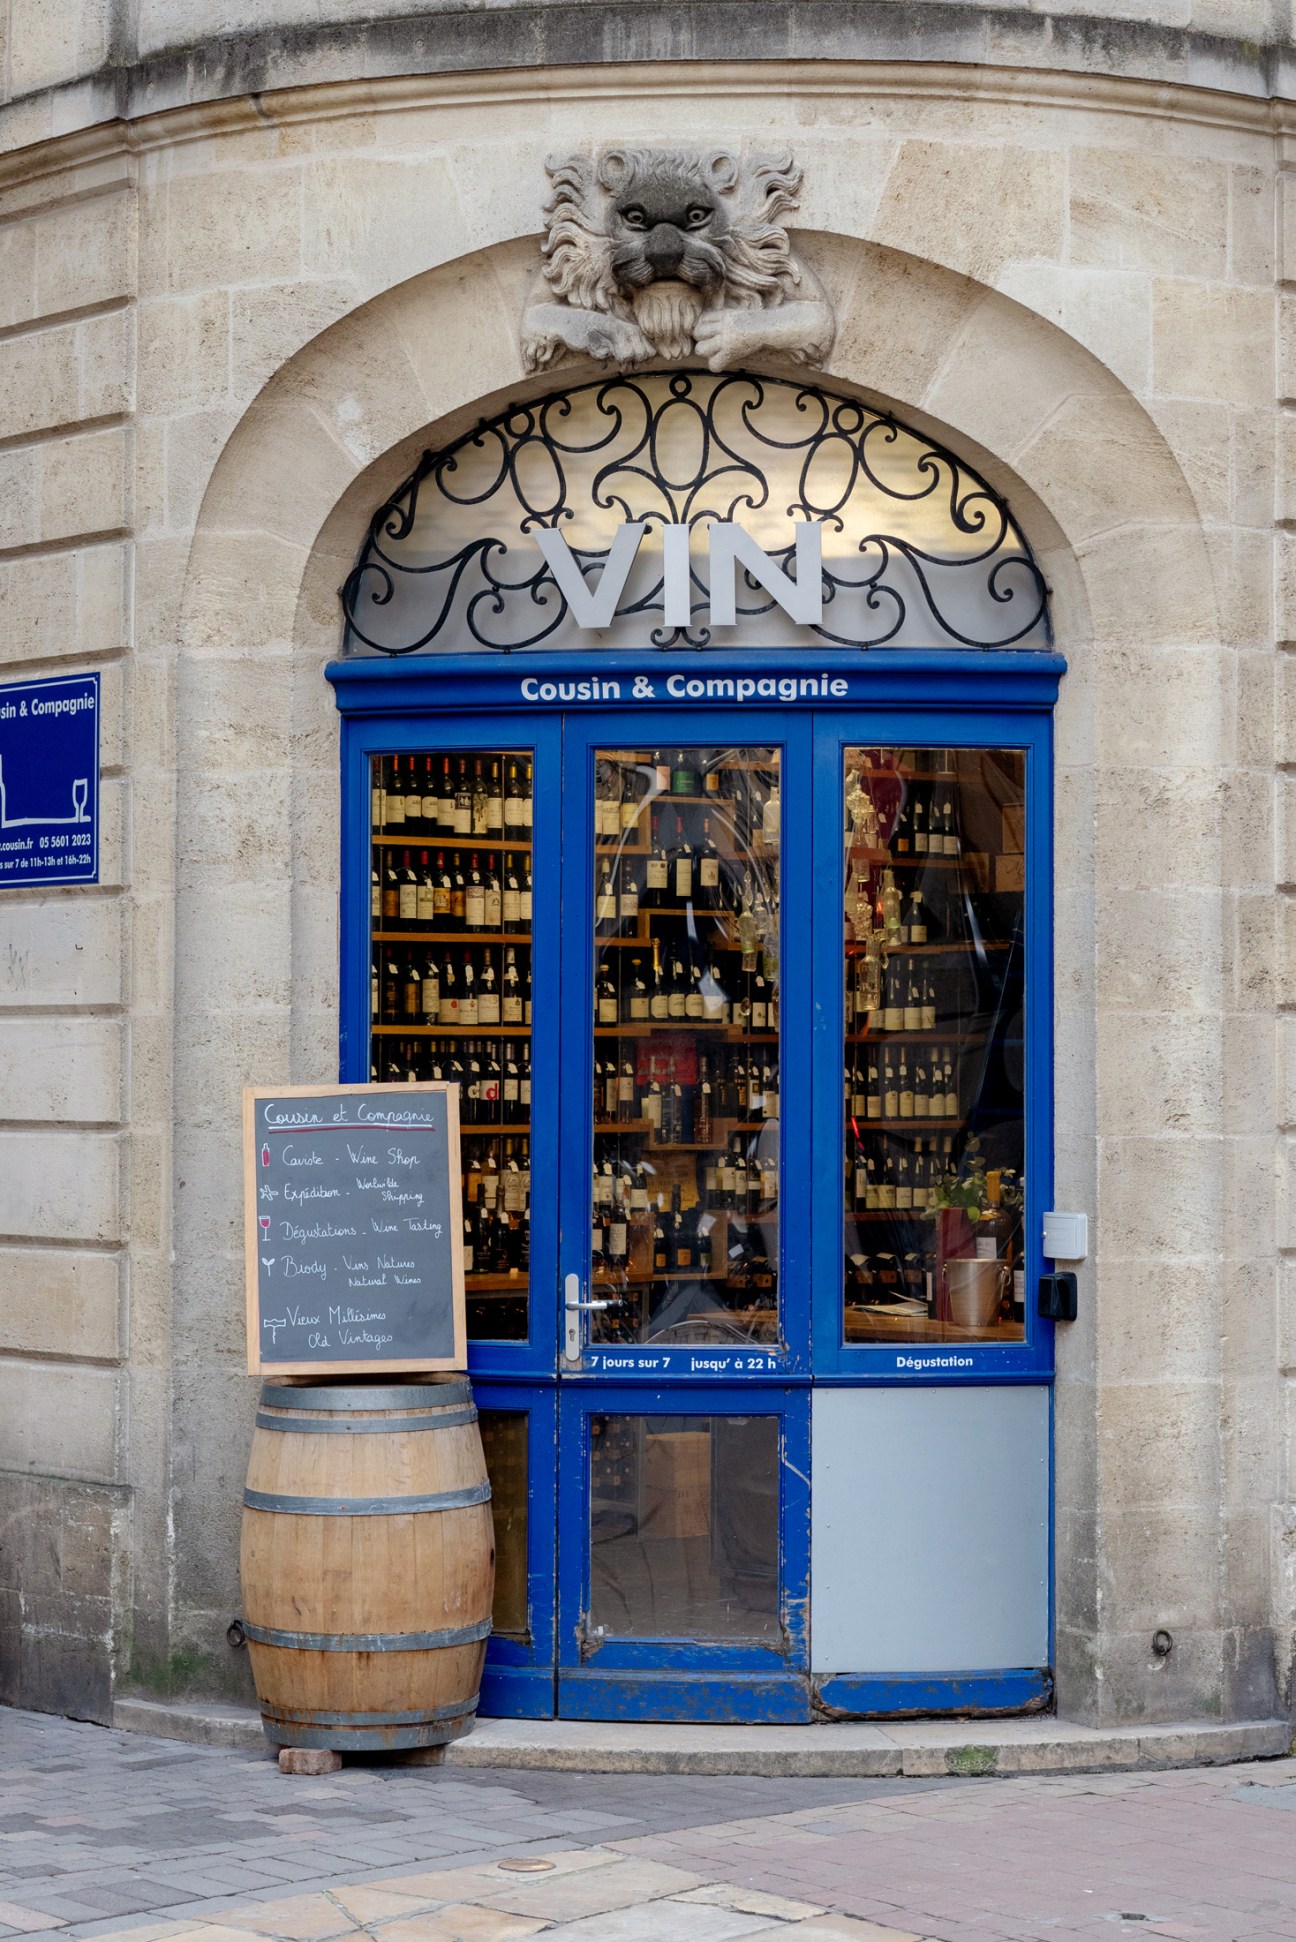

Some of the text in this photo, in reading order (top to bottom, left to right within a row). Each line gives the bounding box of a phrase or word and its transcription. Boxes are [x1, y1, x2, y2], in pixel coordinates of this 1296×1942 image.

[532, 521, 823, 628] VIN
[520, 673, 849, 701] Cousin & Compagnie
[0, 692, 95, 719] sin & Compagnie
[39, 836, 49, 849] 05
[51, 835, 69, 847] 5601
[72, 833, 91, 846] 2023
[4, 861, 15, 869] sur
[15, 859, 20, 868] 7
[20, 858, 29, 868] de
[30, 855, 56, 867] 11h-13h
[57, 857, 63, 866] et
[264, 1103, 434, 1129] Cousin et Compagnie
[282, 1145, 324, 1166] Caviste
[346, 1144, 379, 1165] Wine
[387, 1147, 421, 1169] Shop
[284, 1183, 341, 1207] Expédition
[381, 1190, 425, 1207] Shipping
[280, 1221, 357, 1245] Dégustations
[371, 1218, 399, 1233] Wine
[403, 1217, 443, 1239] Tasting
[281, 1255, 327, 1280] Biody
[342, 1255, 369, 1271] Vins
[377, 1254, 415, 1270] Natures
[348, 1273, 422, 1288] Natural Wines
[286, 1305, 386, 1327] Vieux Millésimes
[308, 1328, 393, 1350] Old Vintages
[591, 1356, 776, 1371] 7 jours sur 7 jusqu' à 22 h
[896, 1356, 973, 1370] Dégustation
